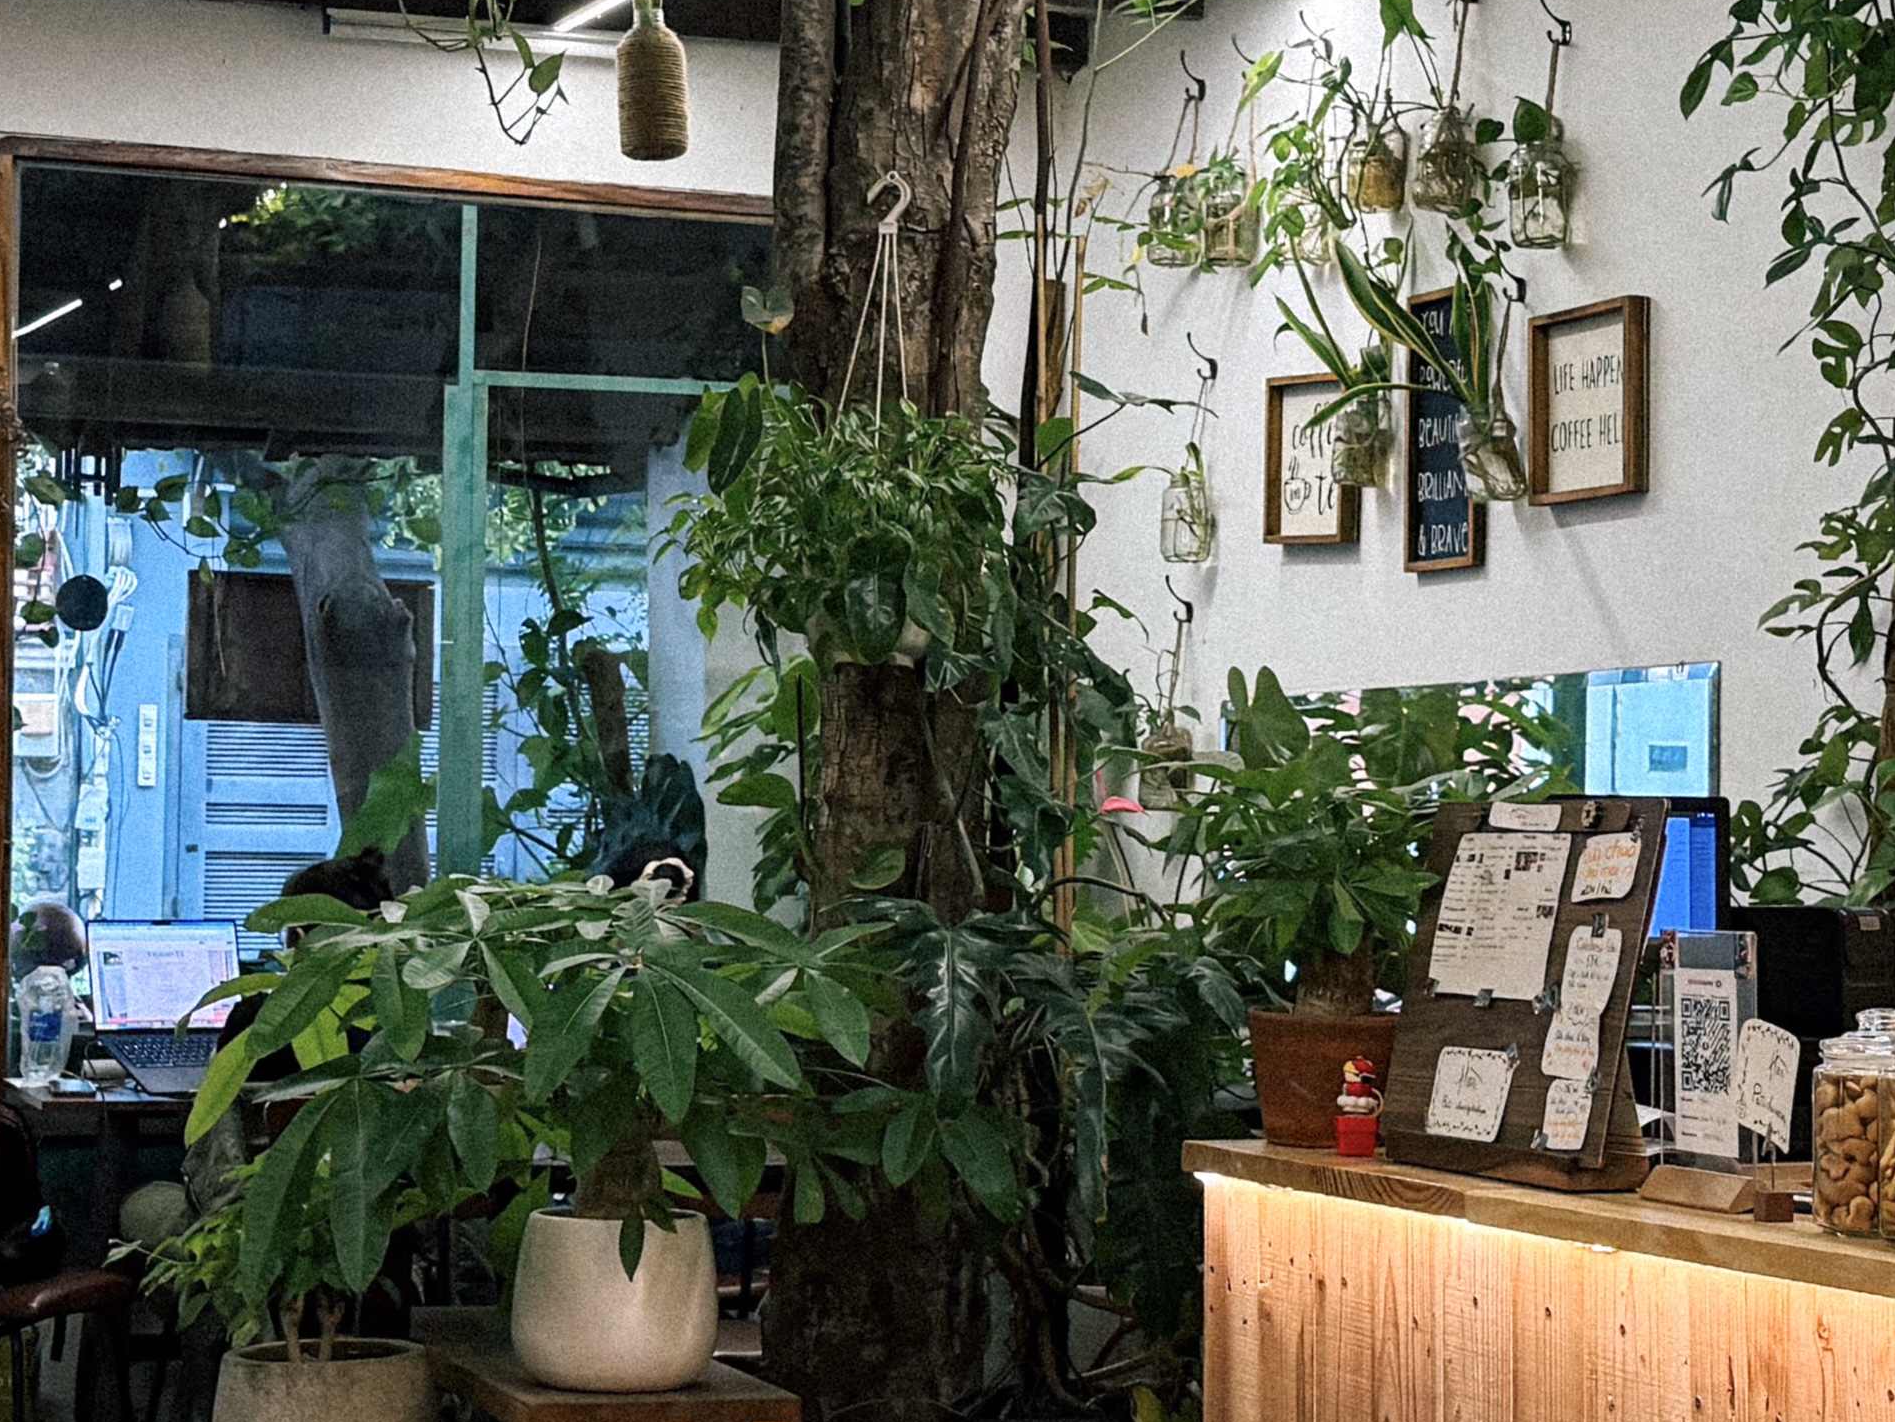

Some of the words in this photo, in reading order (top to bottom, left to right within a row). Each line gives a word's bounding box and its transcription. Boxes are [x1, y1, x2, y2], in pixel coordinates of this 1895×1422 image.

[1554, 363, 1575, 395] LIFE
[1551, 418, 1592, 453] COFFEE
[1599, 412, 1623, 446] HEL
